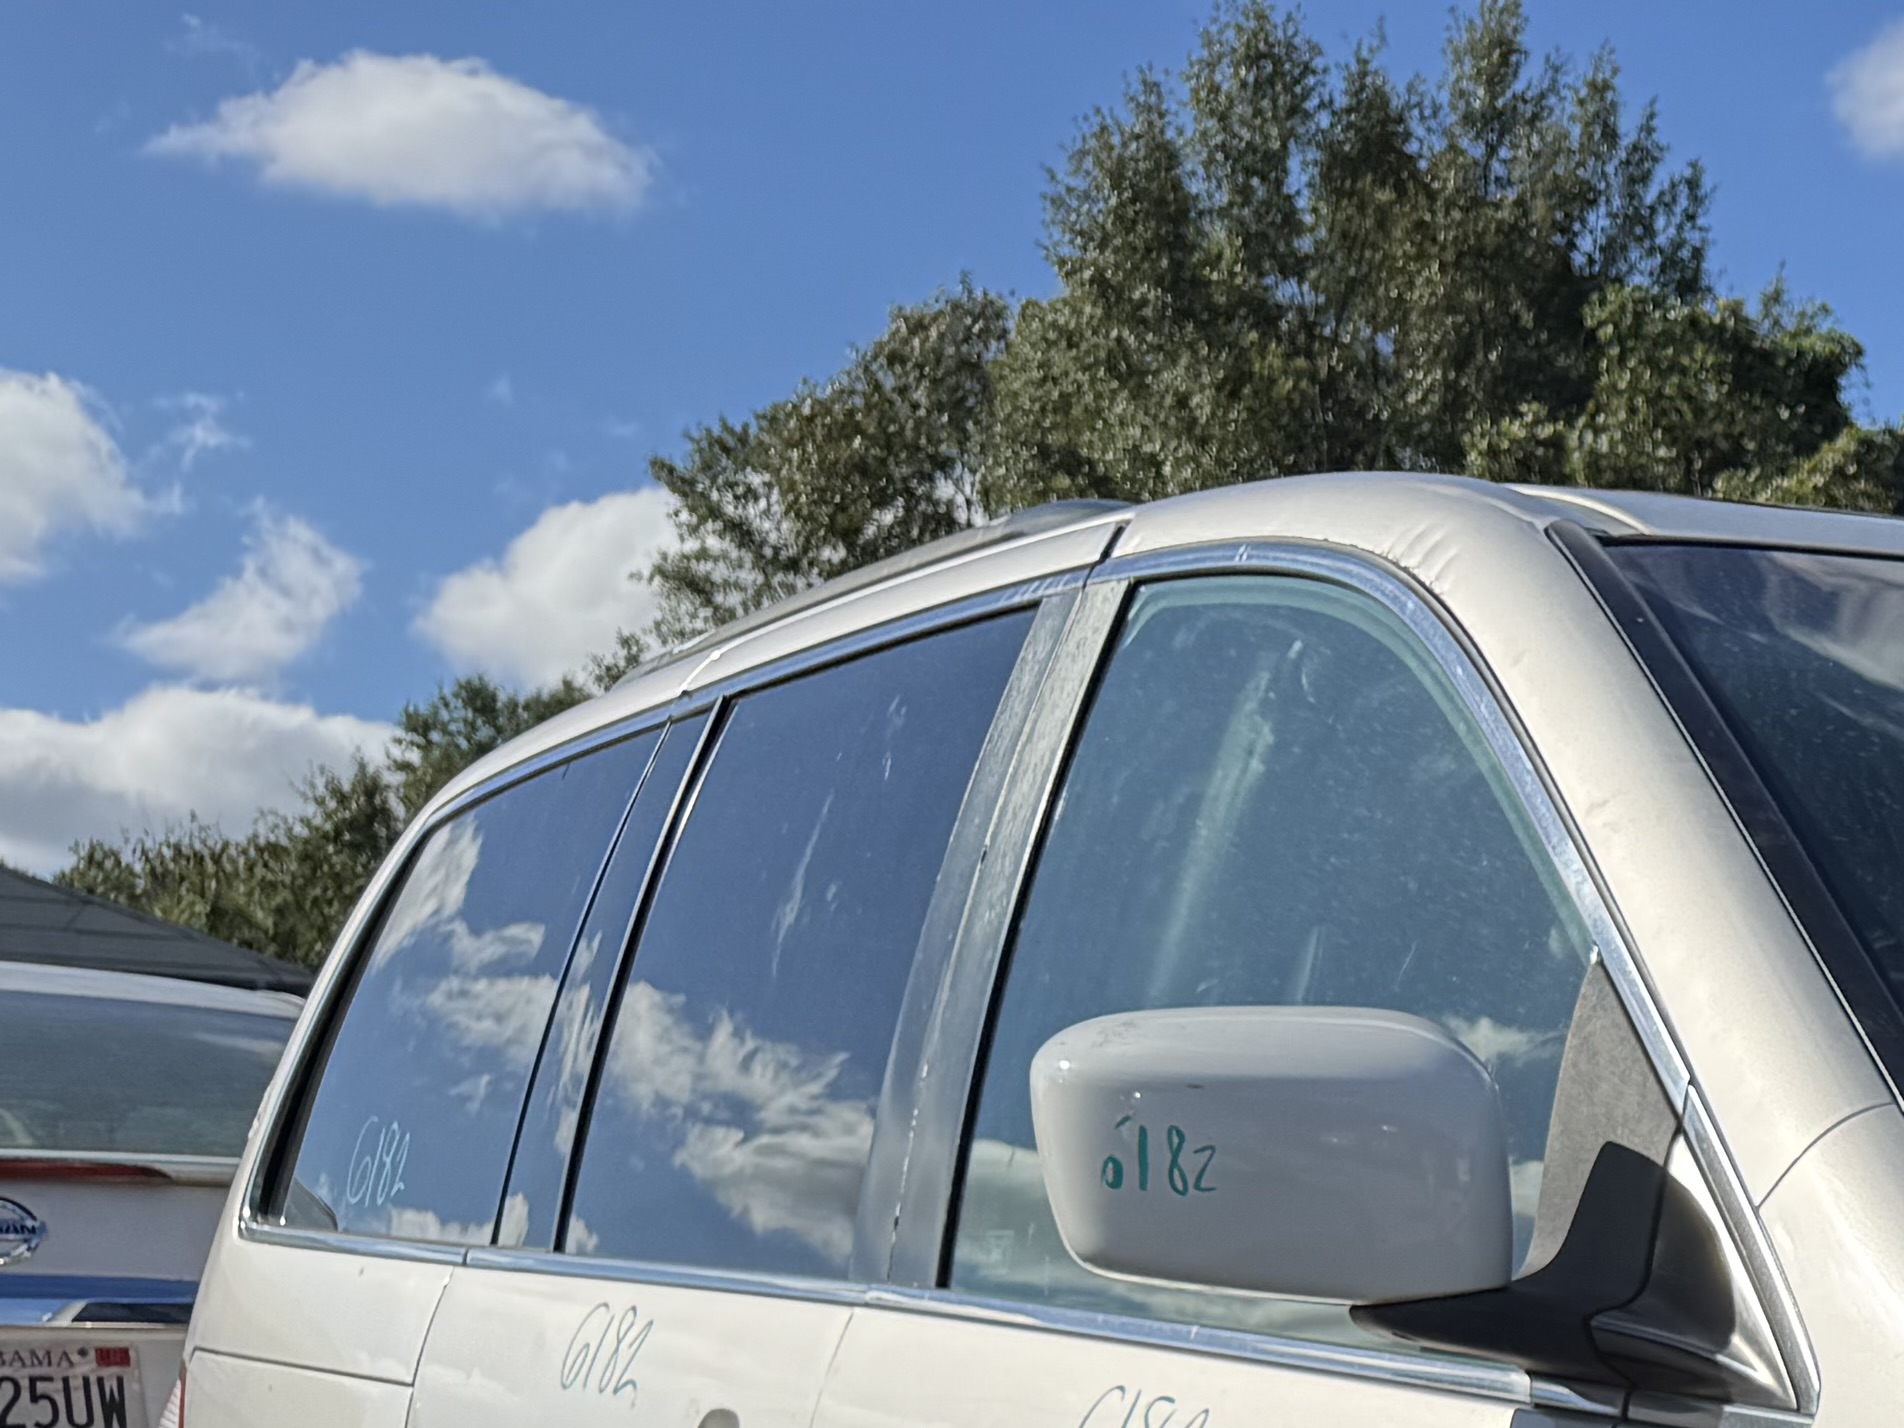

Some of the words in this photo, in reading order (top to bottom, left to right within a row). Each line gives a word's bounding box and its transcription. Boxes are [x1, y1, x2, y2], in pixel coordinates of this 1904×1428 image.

[346, 1115, 410, 1207] 6182
[1101, 1114, 1218, 1196] 6182
[560, 1302, 653, 1409] 6182
